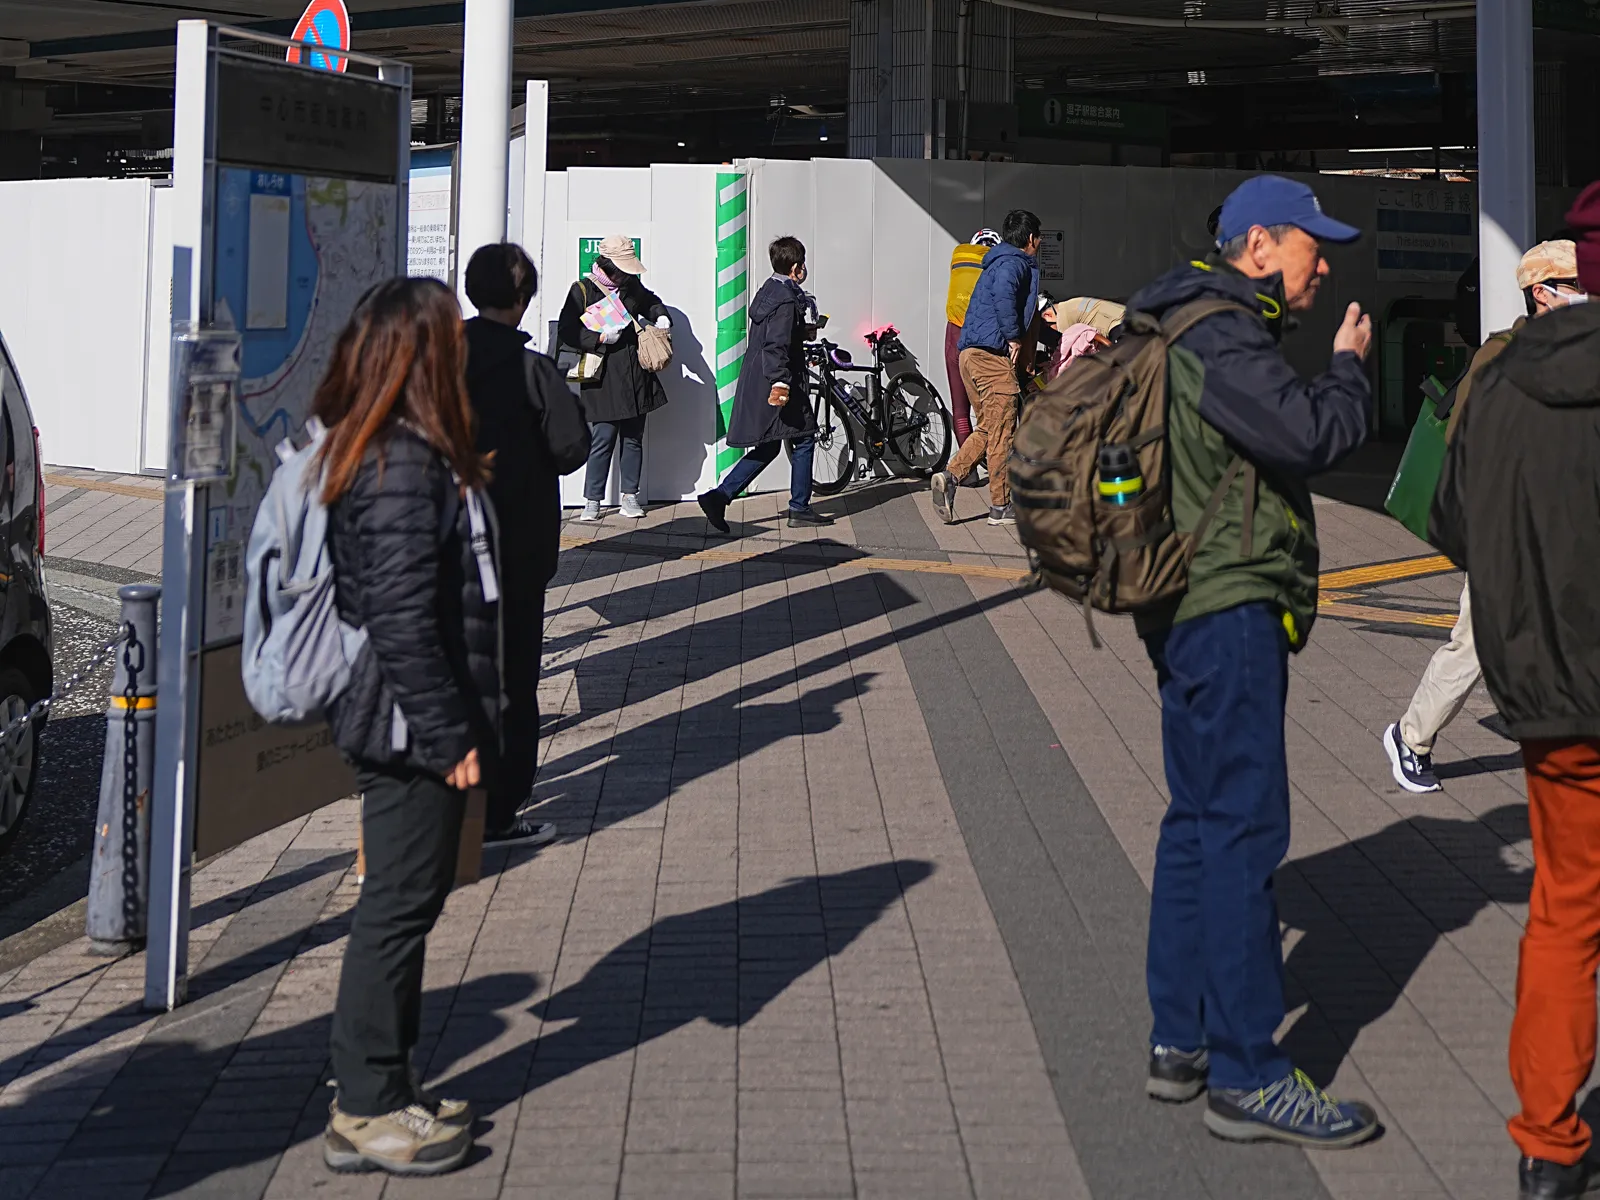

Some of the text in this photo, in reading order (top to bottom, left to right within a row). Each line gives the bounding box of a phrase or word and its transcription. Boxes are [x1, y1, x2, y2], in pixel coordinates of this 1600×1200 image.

[1066, 103, 1120, 120] 逗子駅総合案内
